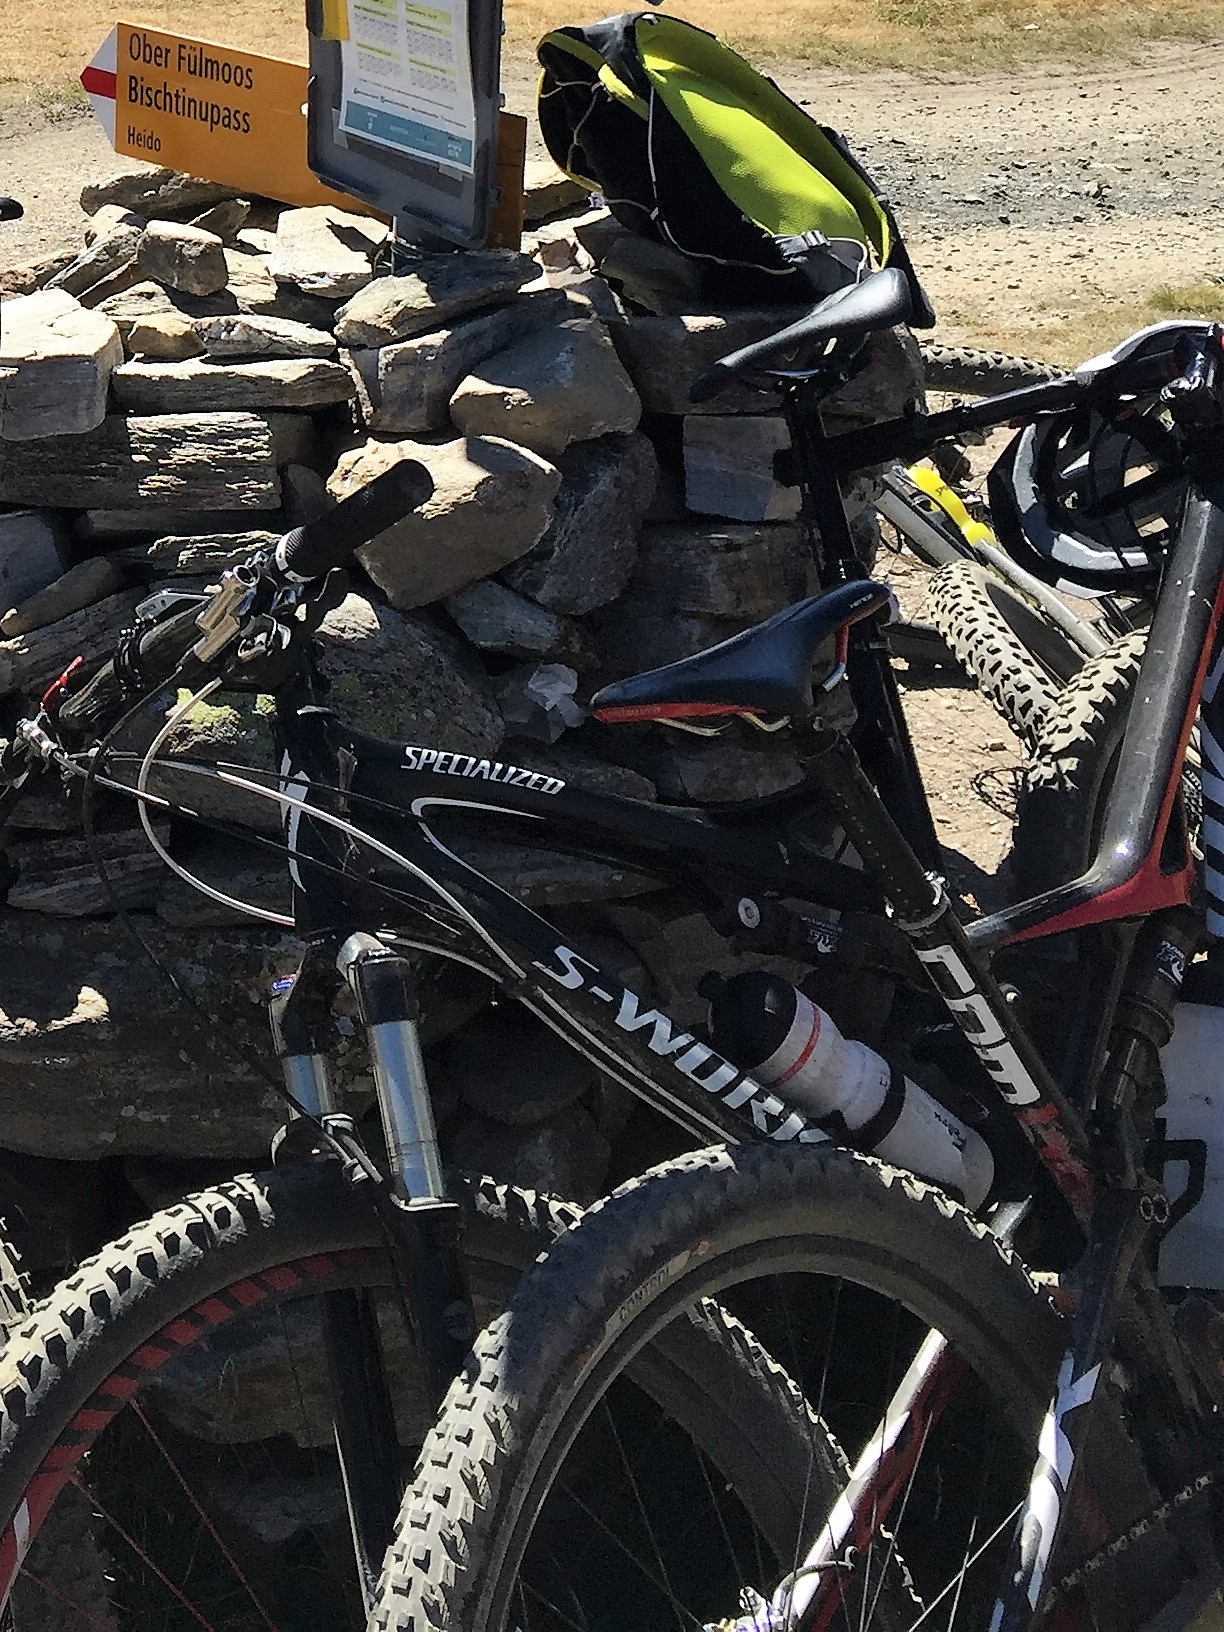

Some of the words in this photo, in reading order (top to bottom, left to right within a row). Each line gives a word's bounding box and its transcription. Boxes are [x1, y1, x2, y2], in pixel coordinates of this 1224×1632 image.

[130, 33, 171, 68] Ober
[178, 44, 253, 89] Fülmoos
[128, 75, 251, 133] Bischtinupass
[128, 125, 161, 151] Heido
[401, 746, 566, 795] SPECIALIZED
